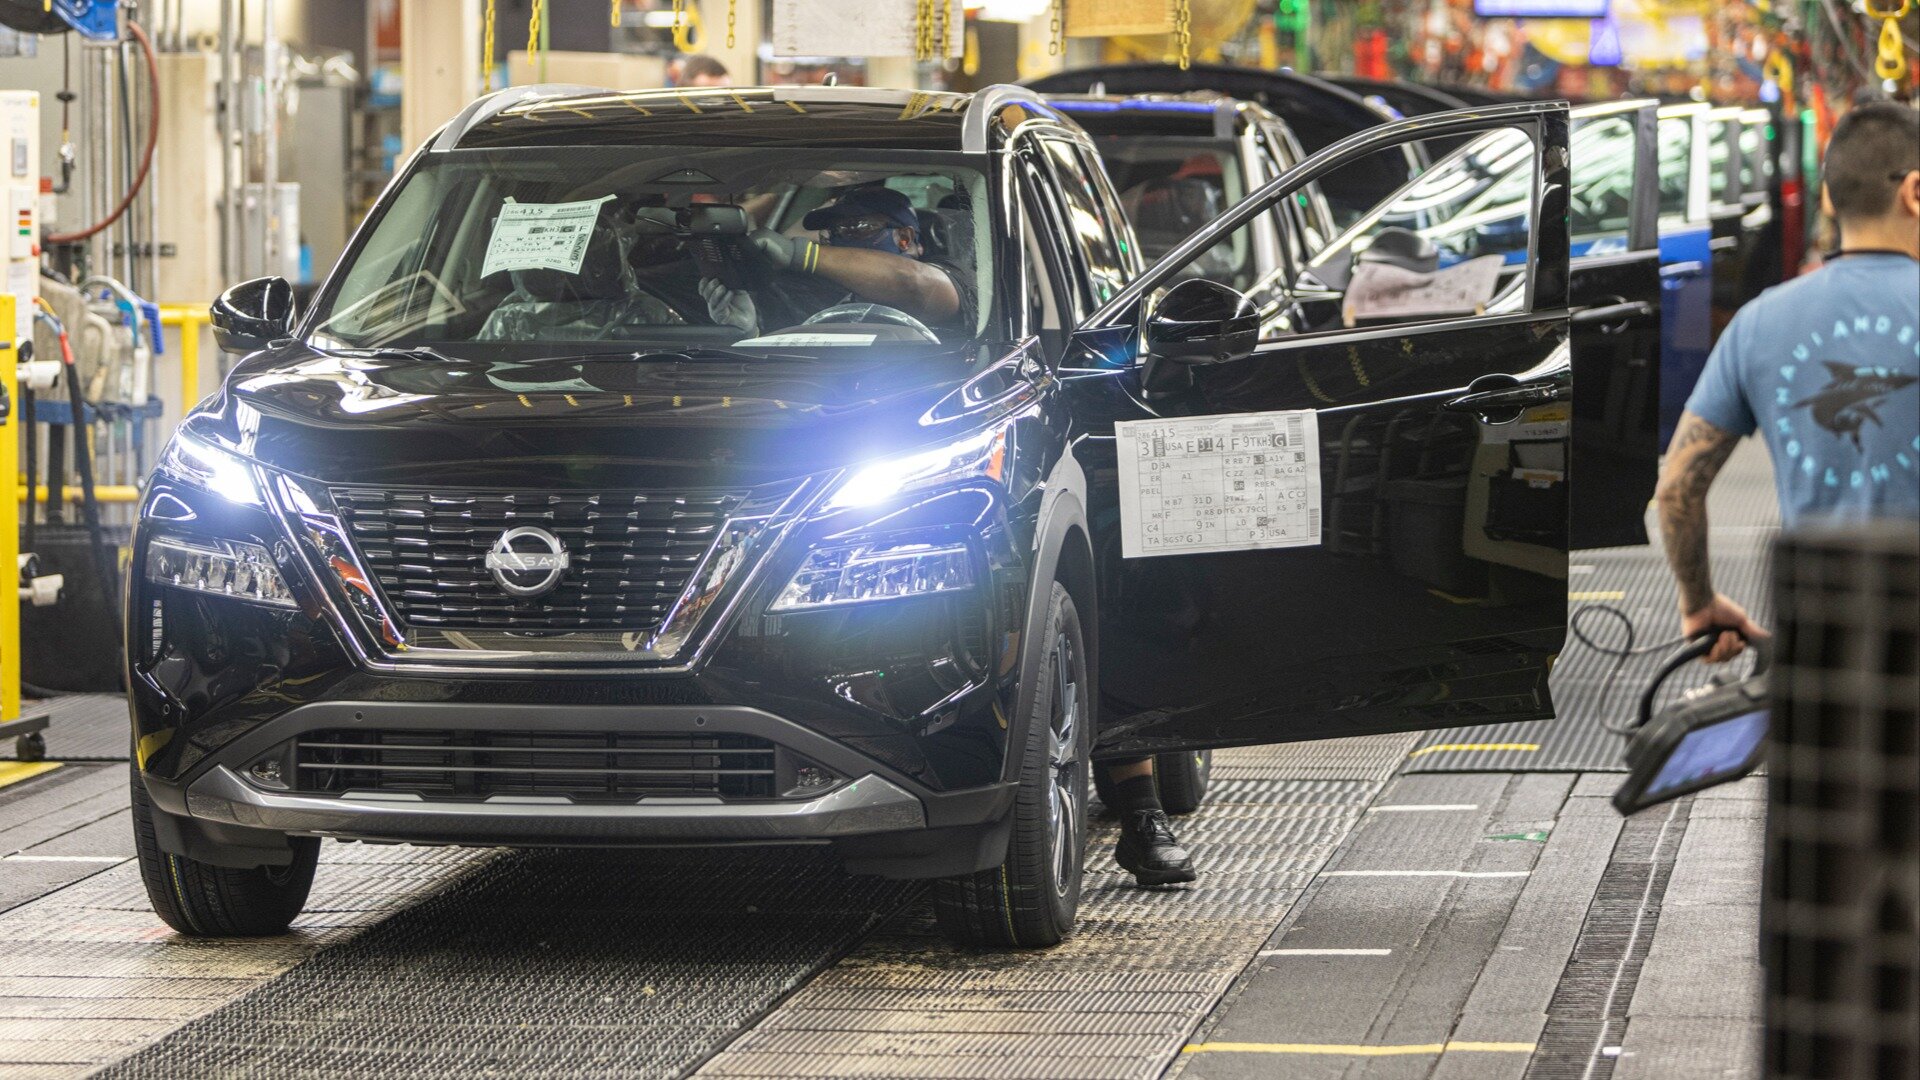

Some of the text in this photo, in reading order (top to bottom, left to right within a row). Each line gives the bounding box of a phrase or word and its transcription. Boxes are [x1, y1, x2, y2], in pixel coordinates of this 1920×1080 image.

[1833, 315, 1891, 338] AND
[1142, 442, 1150, 456] 3
[1165, 443, 1183, 451] USA
[1187, 441, 1195, 453] E
[1198, 438, 1213, 452] 31
[1216, 438, 1225, 451] 4
[1231, 438, 1239, 450] F
[1196, 521, 1202, 529] 9
[1260, 530, 1265, 538] 3
[1269, 529, 1286, 537] USA
[488, 556, 566, 567] SSAN
